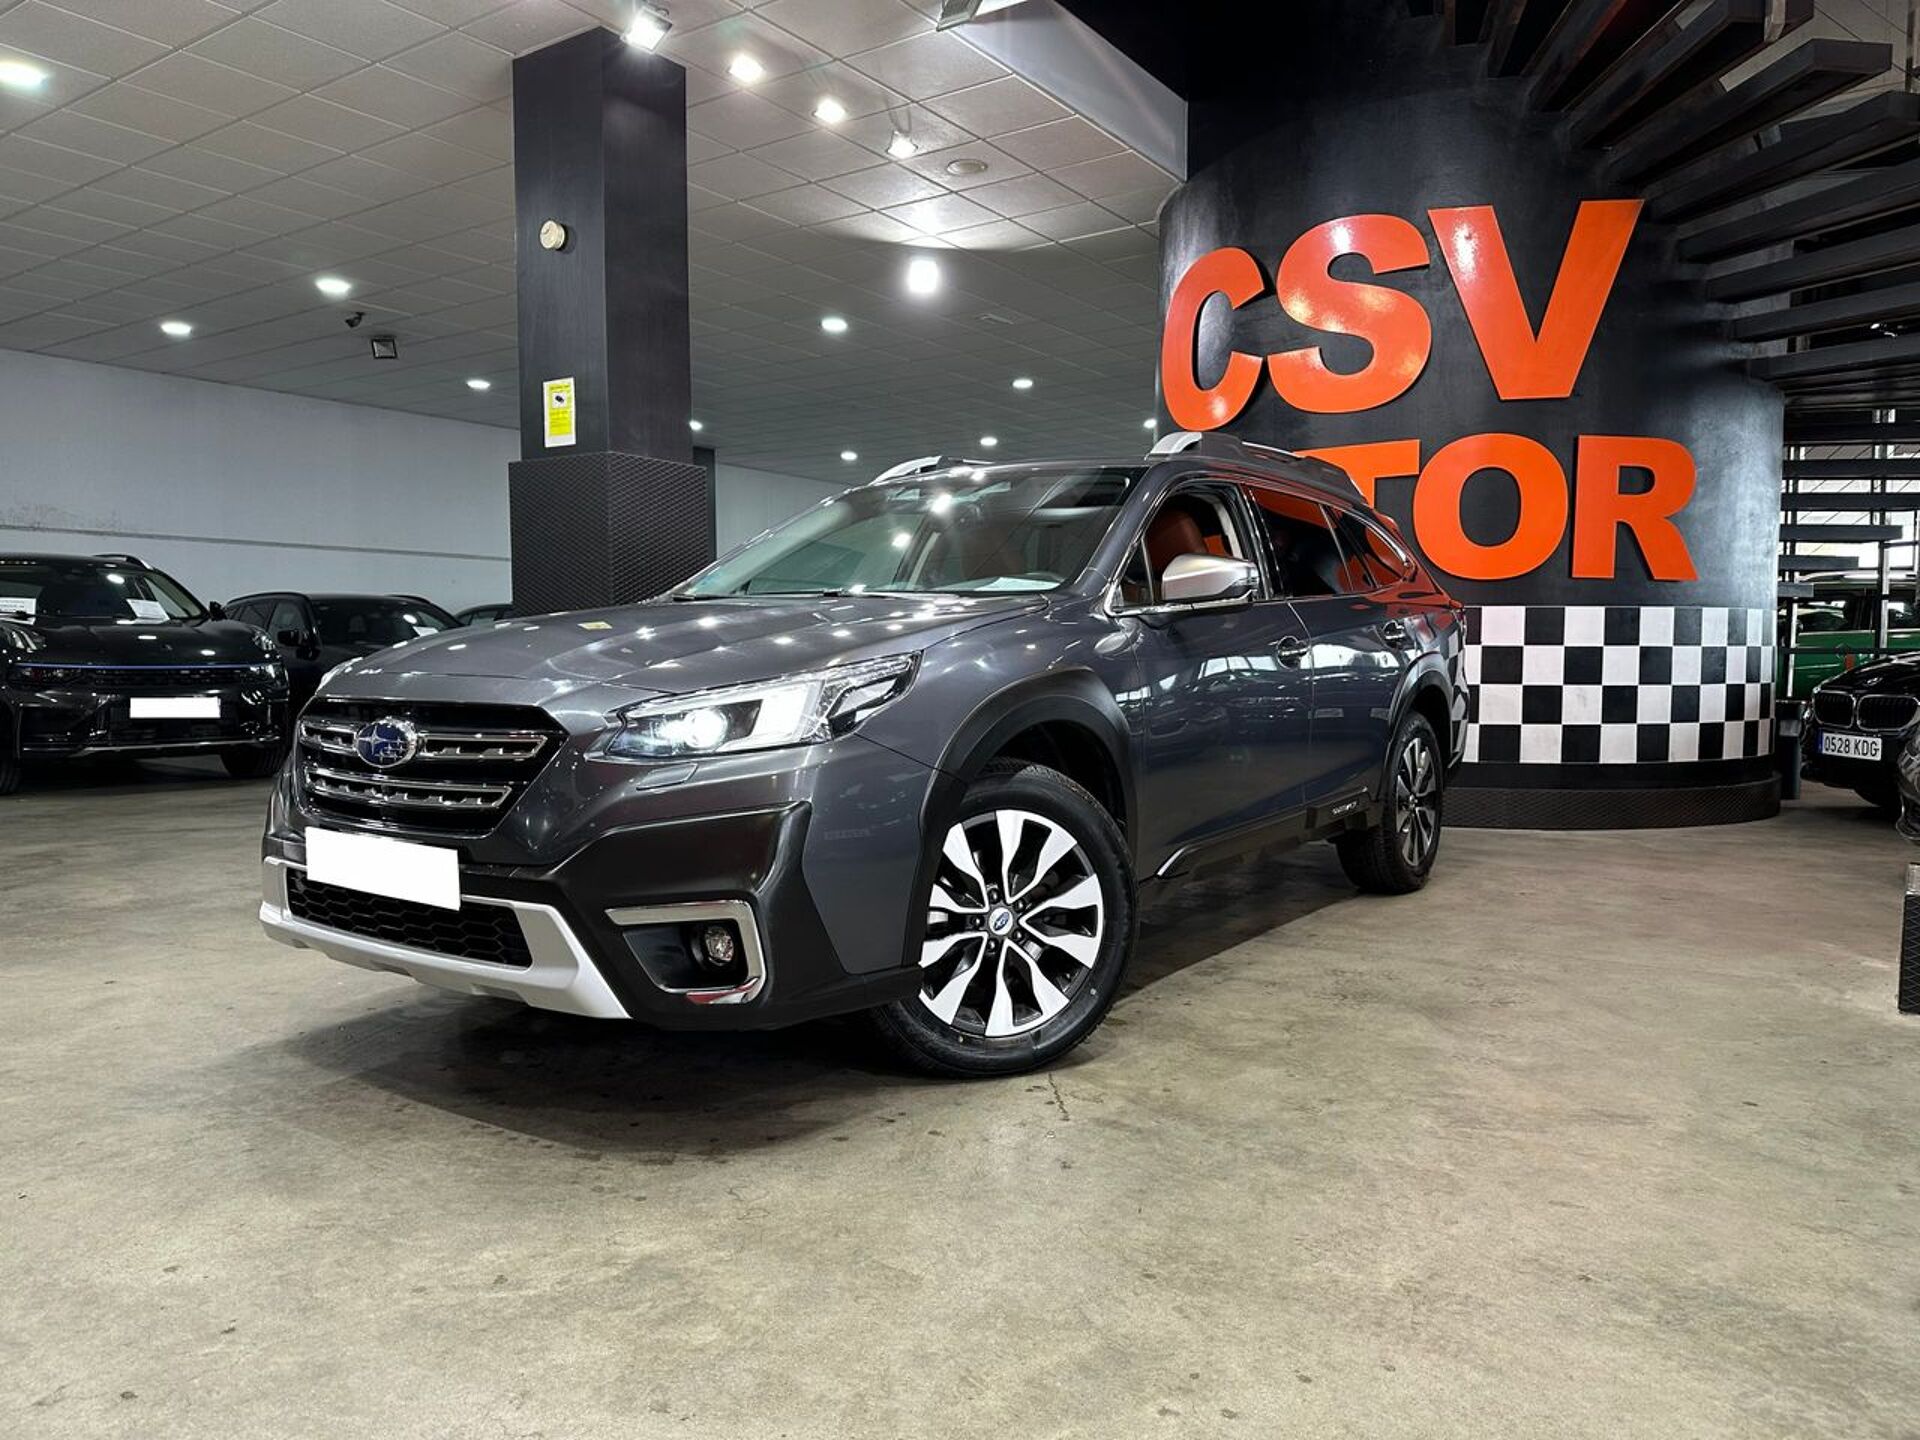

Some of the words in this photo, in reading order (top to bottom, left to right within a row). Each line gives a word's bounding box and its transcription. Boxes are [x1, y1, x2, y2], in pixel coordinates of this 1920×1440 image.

[1161, 199, 1645, 432] CSV
[1824, 735, 1851, 754] 0528
[1853, 738, 1880, 757] KDG
